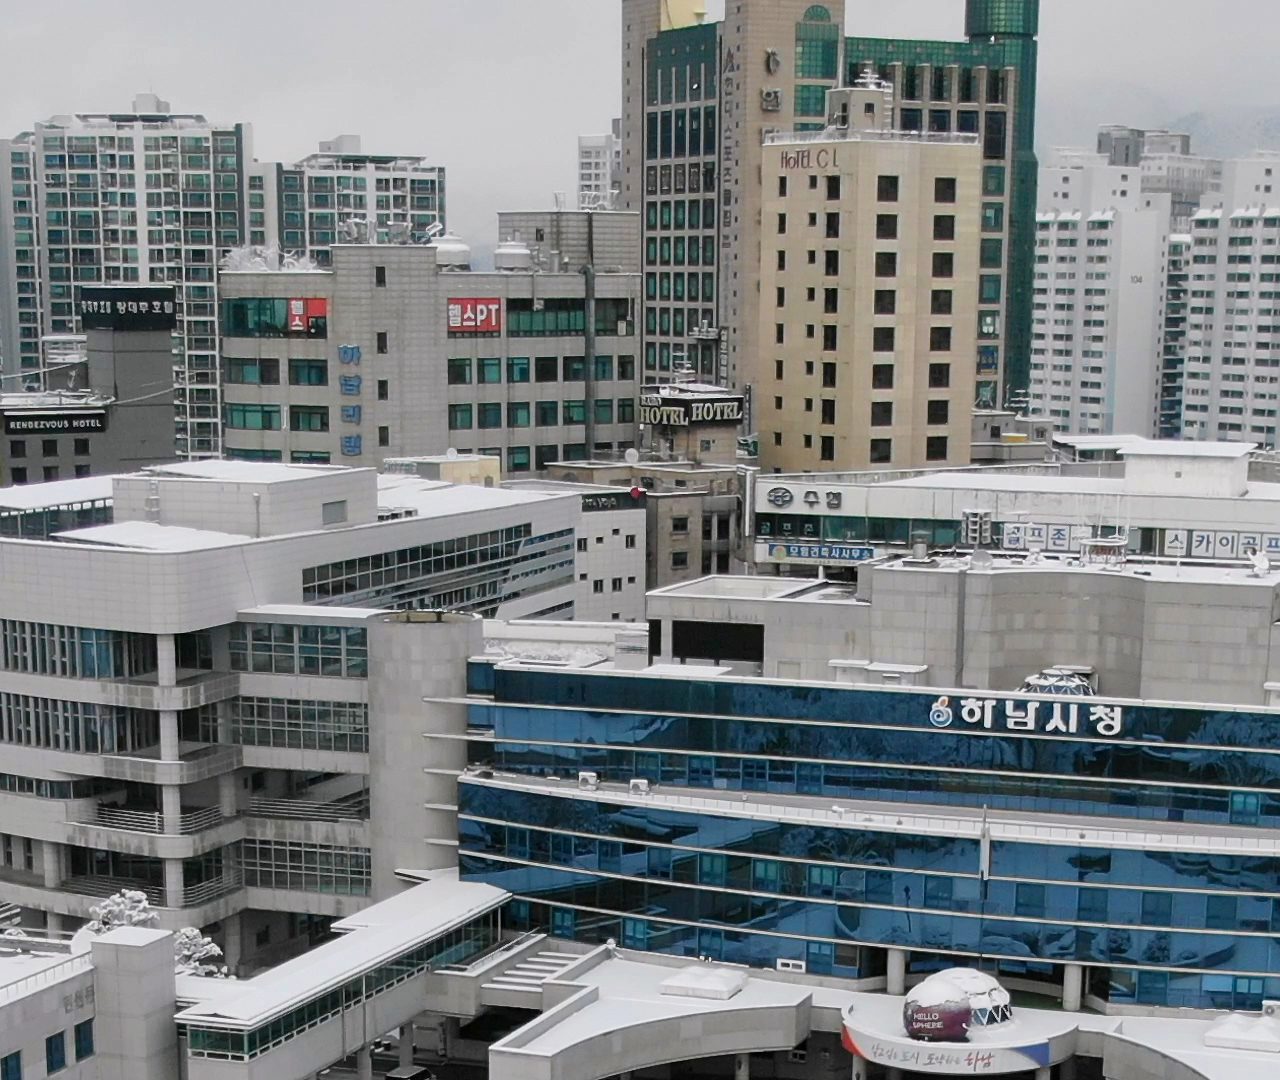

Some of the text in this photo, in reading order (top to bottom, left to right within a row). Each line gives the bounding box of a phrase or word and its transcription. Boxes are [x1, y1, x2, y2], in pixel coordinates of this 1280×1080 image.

[1130, 275, 1143, 284] 104
[290, 300, 306, 331] 헬스
[448, 304, 499, 327] 헬스PT
[640, 406, 689, 426] HOTEL
[691, 402, 742, 421] HOTEL
[10, 419, 102, 429] RENDEZVOUS HOTEL
[1006, 526, 1067, 547] 골프존
[960, 696, 1123, 735] 하남시청
[913, 1012, 939, 1021] HELLO
[900, 1050, 920, 1065] 도시
[963, 1051, 995, 1072] 하남
